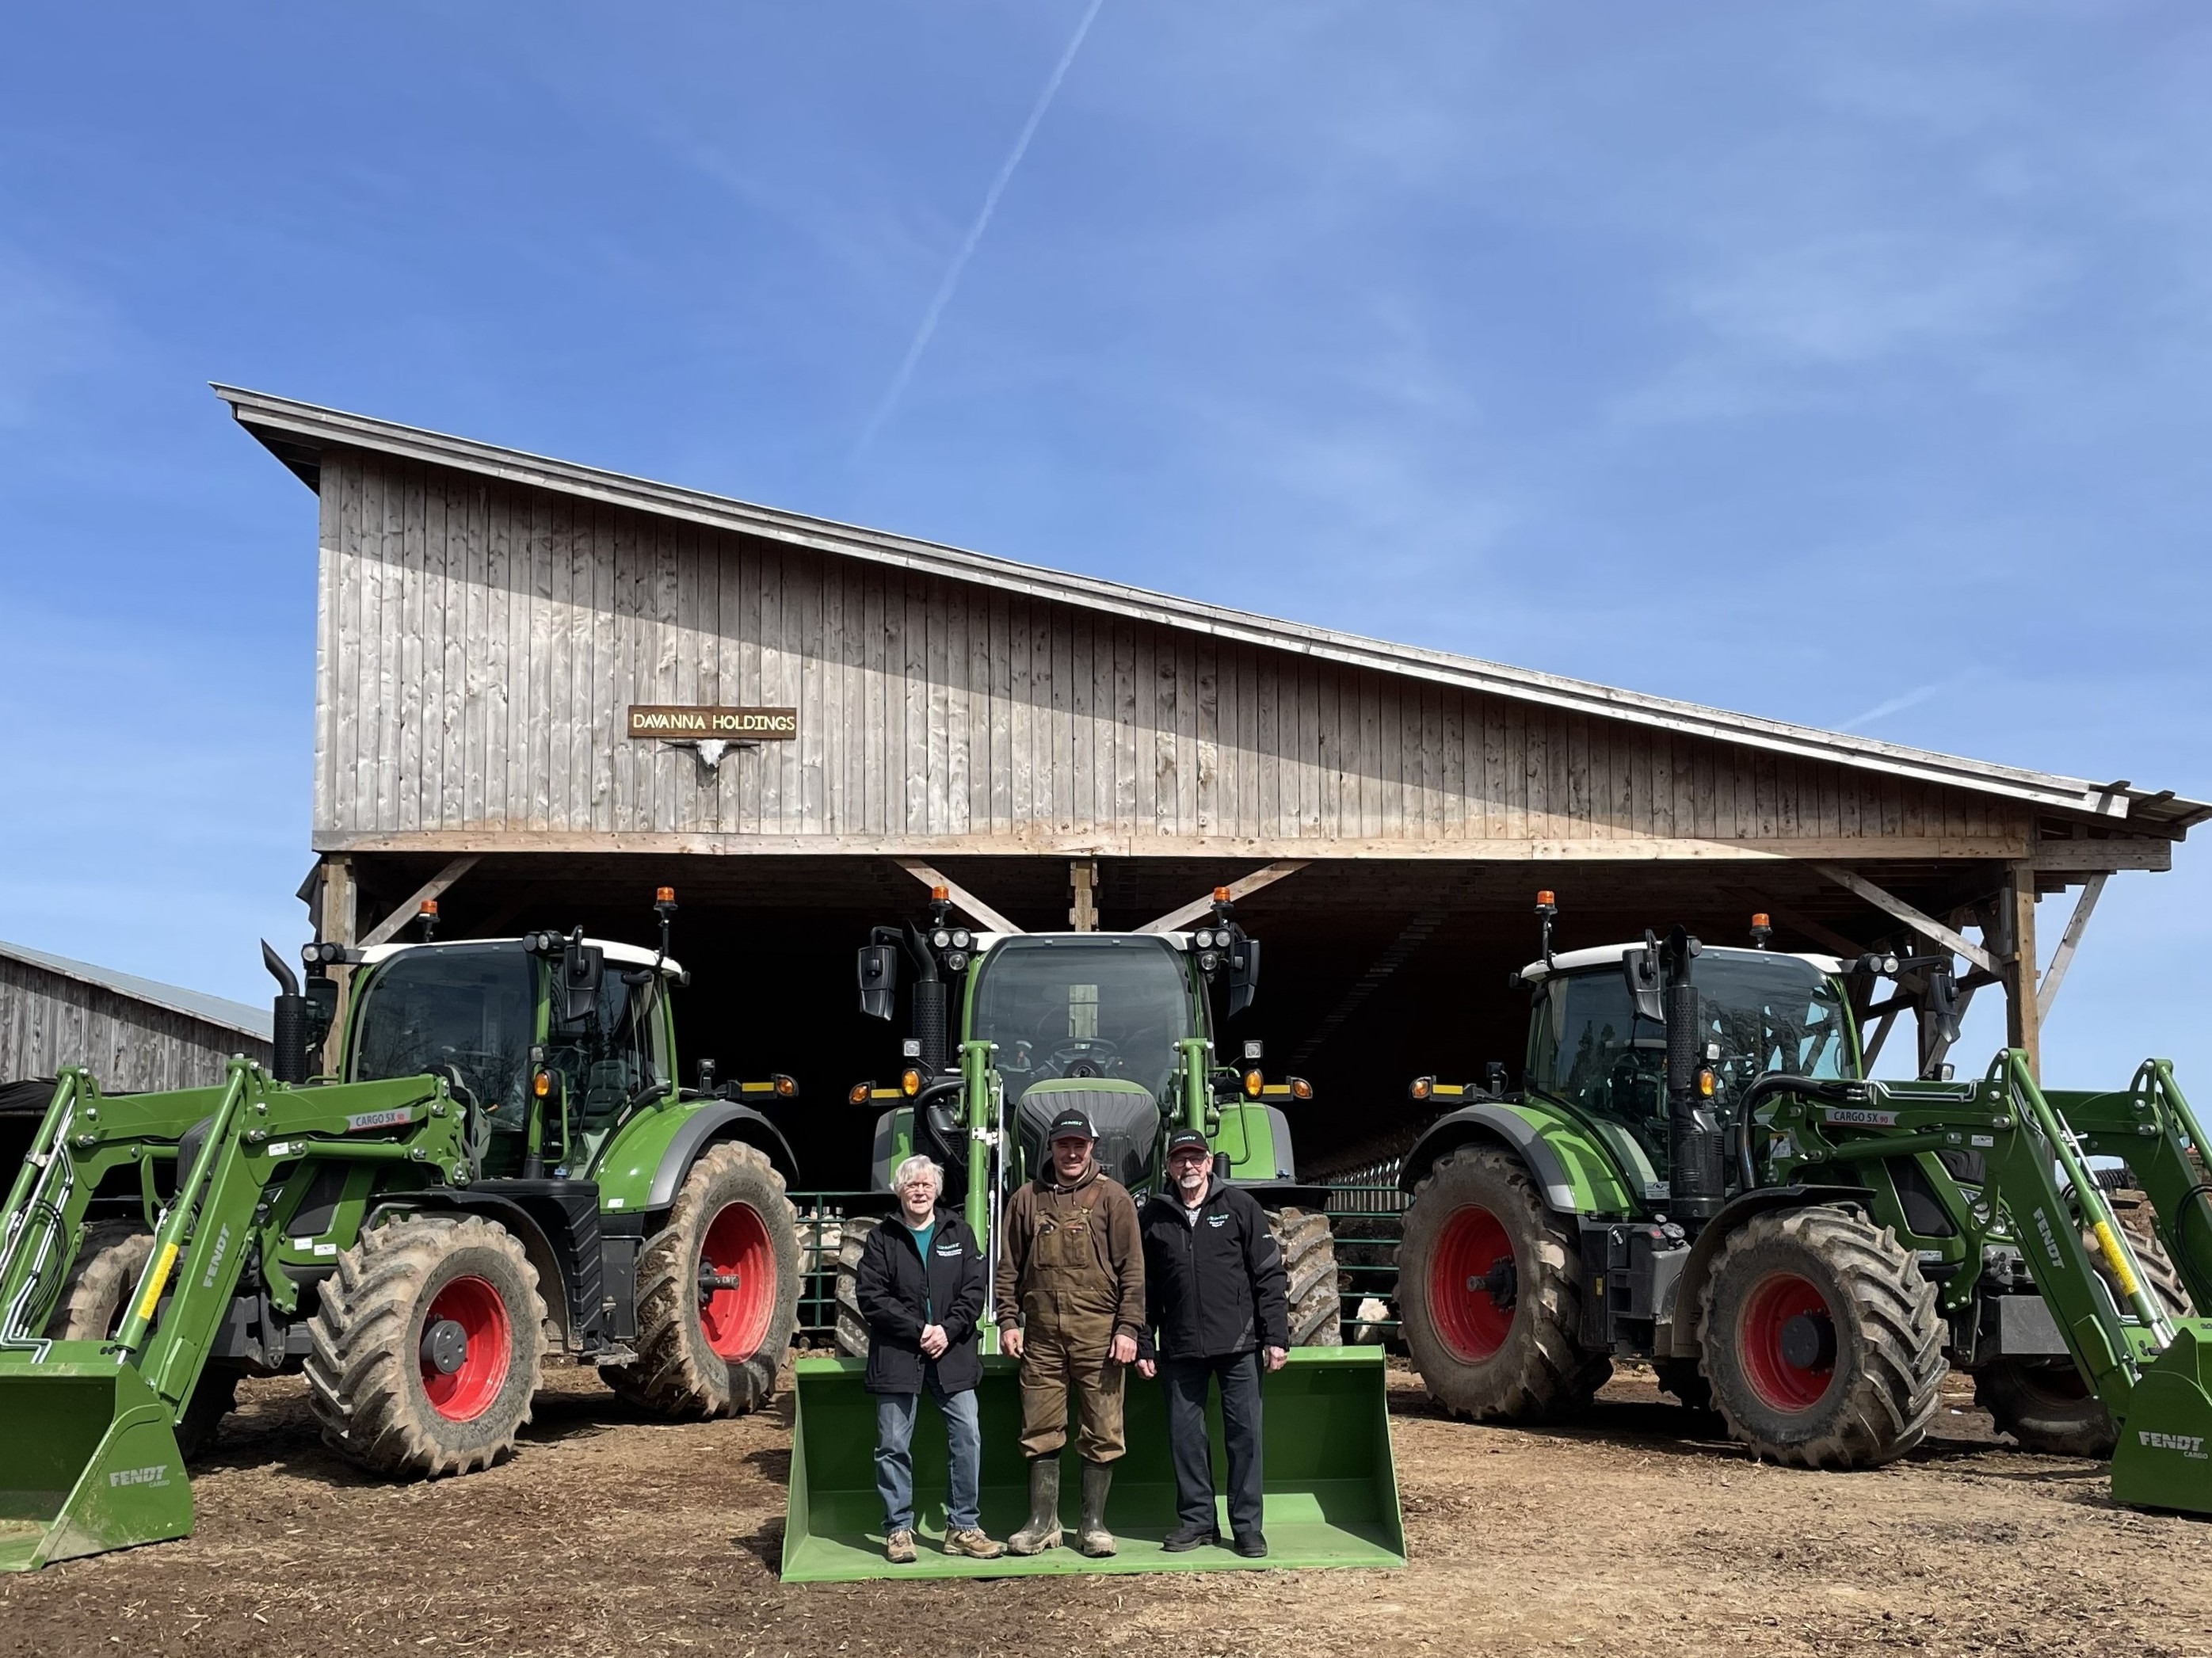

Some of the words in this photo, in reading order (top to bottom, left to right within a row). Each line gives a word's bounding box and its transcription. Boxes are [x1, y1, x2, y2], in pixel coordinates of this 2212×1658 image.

[633, 714, 706, 729] DAVANNA
[712, 715, 795, 730] HOLDINGS
[356, 1114, 384, 1126] CARGO
[385, 1112, 396, 1122] 5X
[1834, 1111, 1865, 1122] CARGO
[1867, 1113, 1878, 1122] 5X
[1879, 1115, 1889, 1124] 90
[2033, 1206, 2065, 1269] FENDT
[203, 1222, 230, 1288] FENDT
[2138, 1431, 2204, 1451] FENDT
[109, 1465, 167, 1487] FENDT
